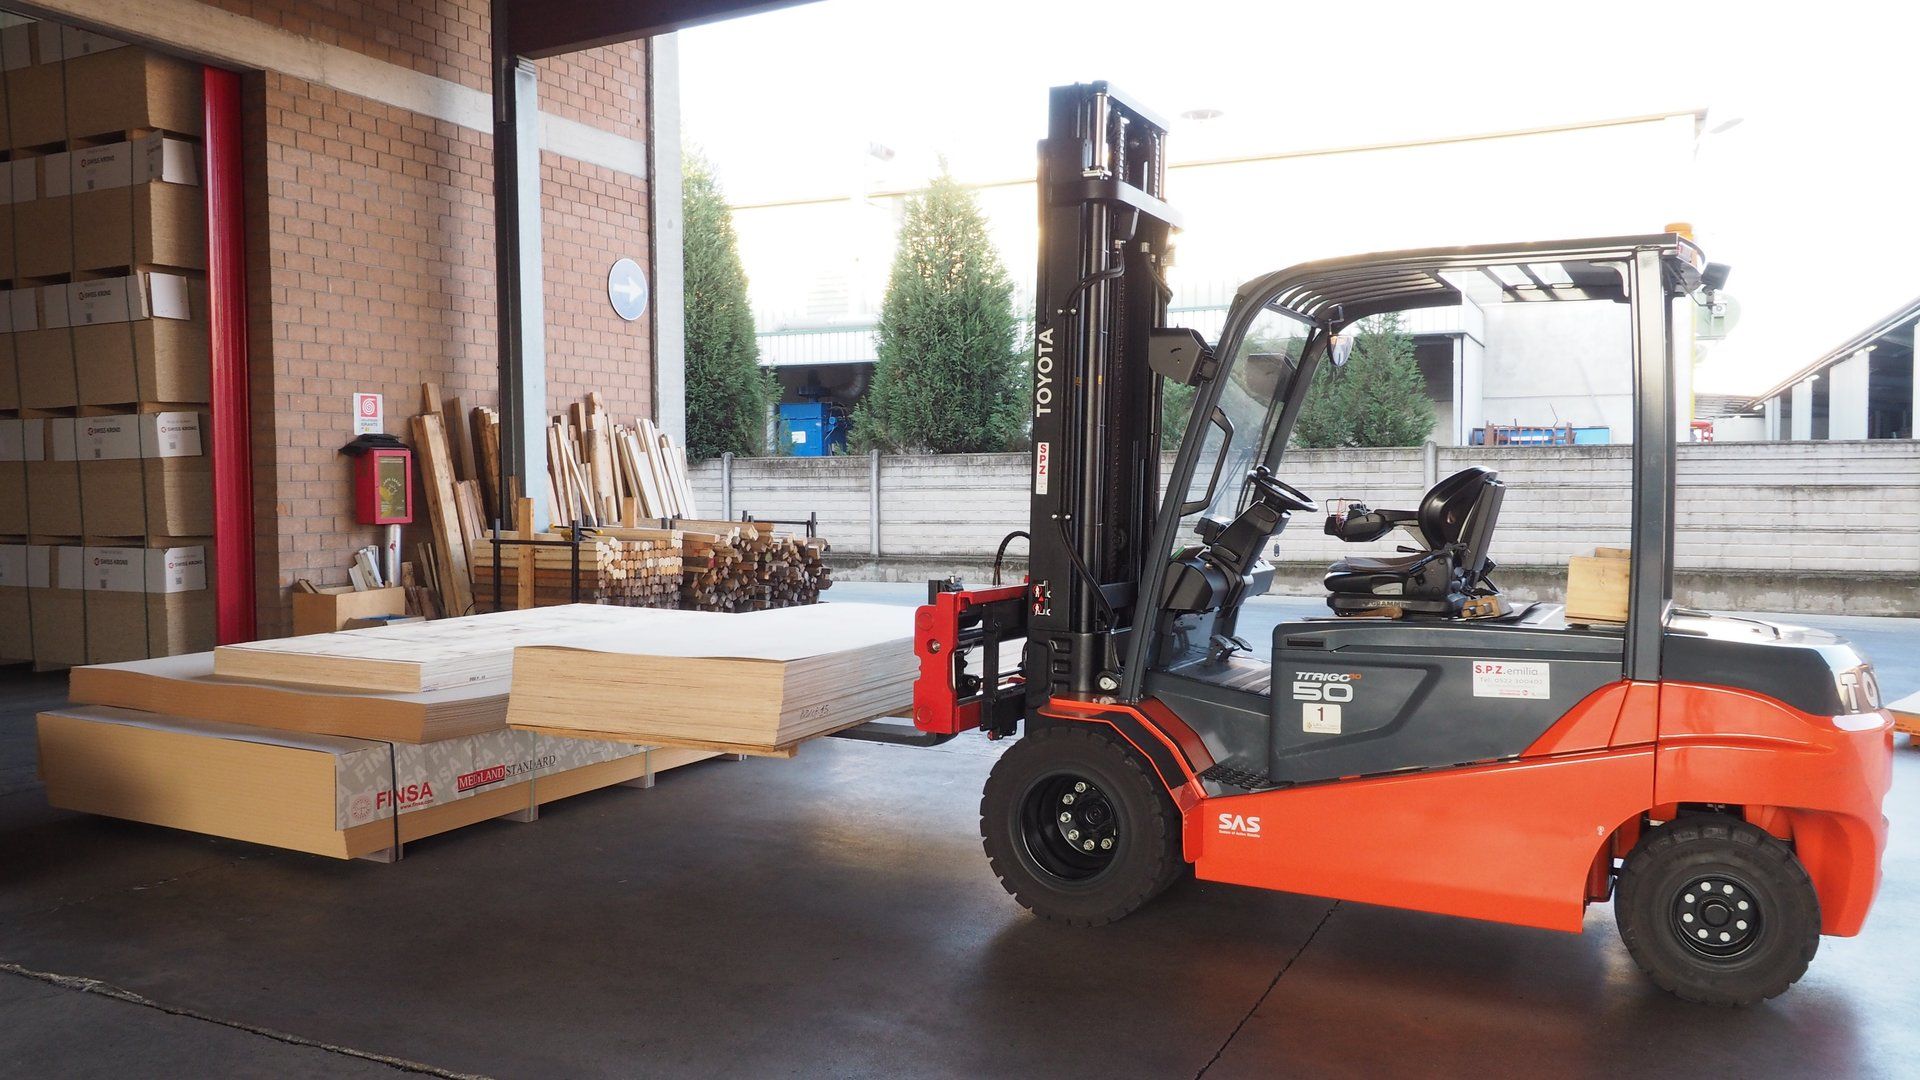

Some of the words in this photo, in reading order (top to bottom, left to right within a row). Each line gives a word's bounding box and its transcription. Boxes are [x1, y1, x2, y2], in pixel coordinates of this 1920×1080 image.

[1036, 328, 1054, 418] TOYOTA
[1292, 681, 1354, 703] 50
[1317, 706, 1324, 722] 1
[375, 781, 434, 810] FINSA
[1218, 813, 1261, 833] SAS
